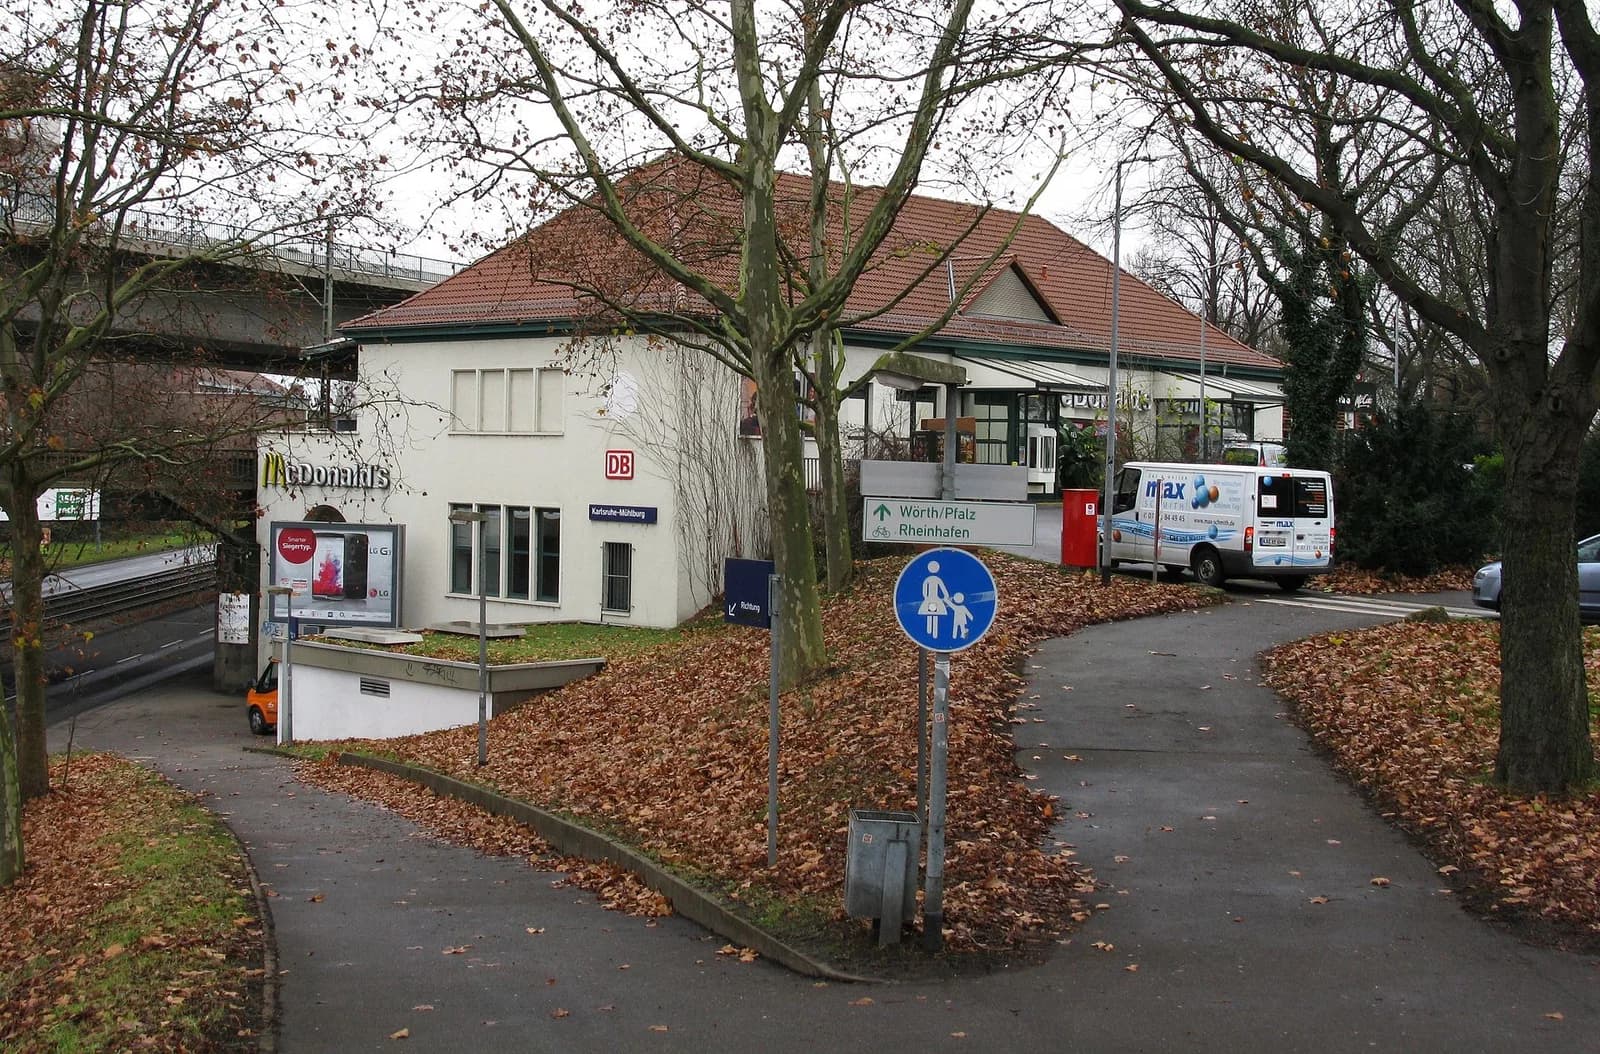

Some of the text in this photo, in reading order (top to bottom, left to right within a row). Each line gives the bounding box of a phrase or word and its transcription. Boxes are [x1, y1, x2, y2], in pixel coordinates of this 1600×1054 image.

[262, 451, 390, 489] McDonald's
[608, 455, 630, 474] DB
[1145, 481, 1186, 500] max
[899, 505, 976, 520] Wörth/Pfalz
[1144, 501, 1185, 511] SCMITH
[899, 524, 970, 538] Rheinhafen
[740, 601, 760, 613] Richtung
